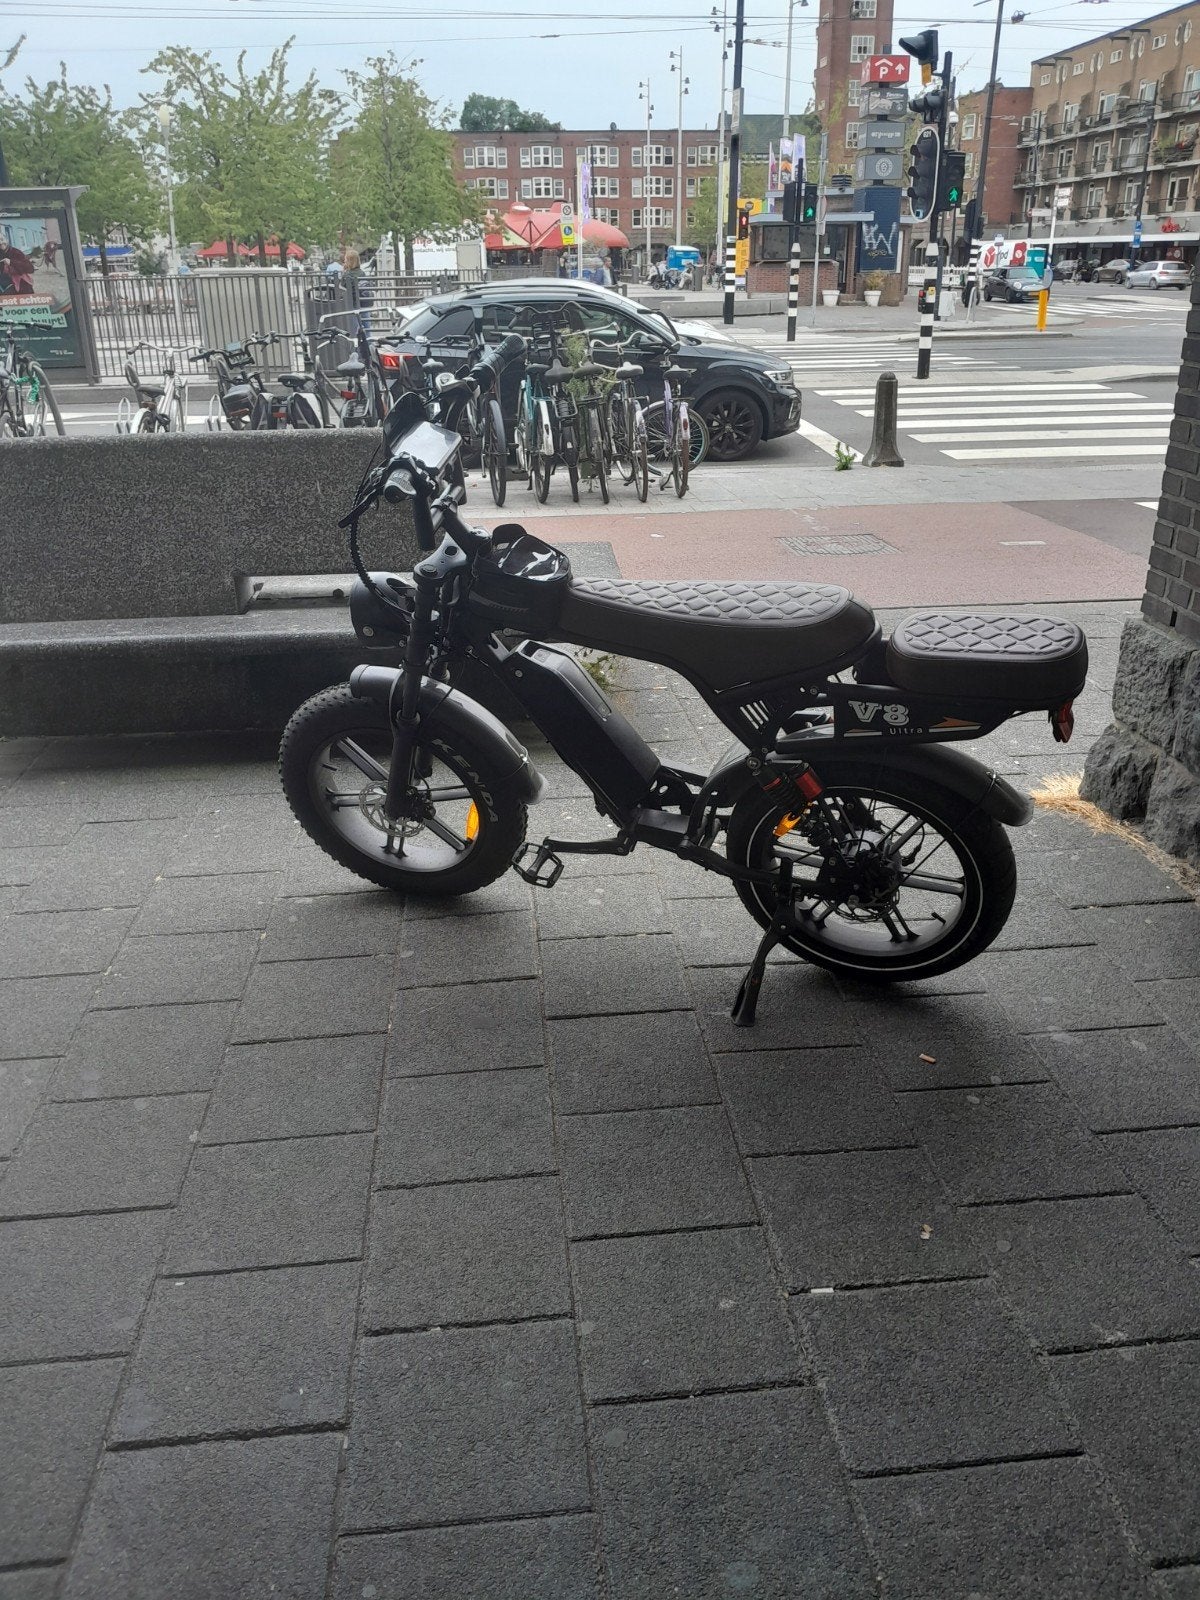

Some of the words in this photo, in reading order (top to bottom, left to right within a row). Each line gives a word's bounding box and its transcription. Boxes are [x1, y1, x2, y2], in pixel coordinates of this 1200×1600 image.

[19, 296, 52, 304] achter
[30, 307, 49, 315] een
[848, 700, 910, 726] V8
[889, 727, 923, 735] Ultra
[431, 738, 498, 822] KENDA
